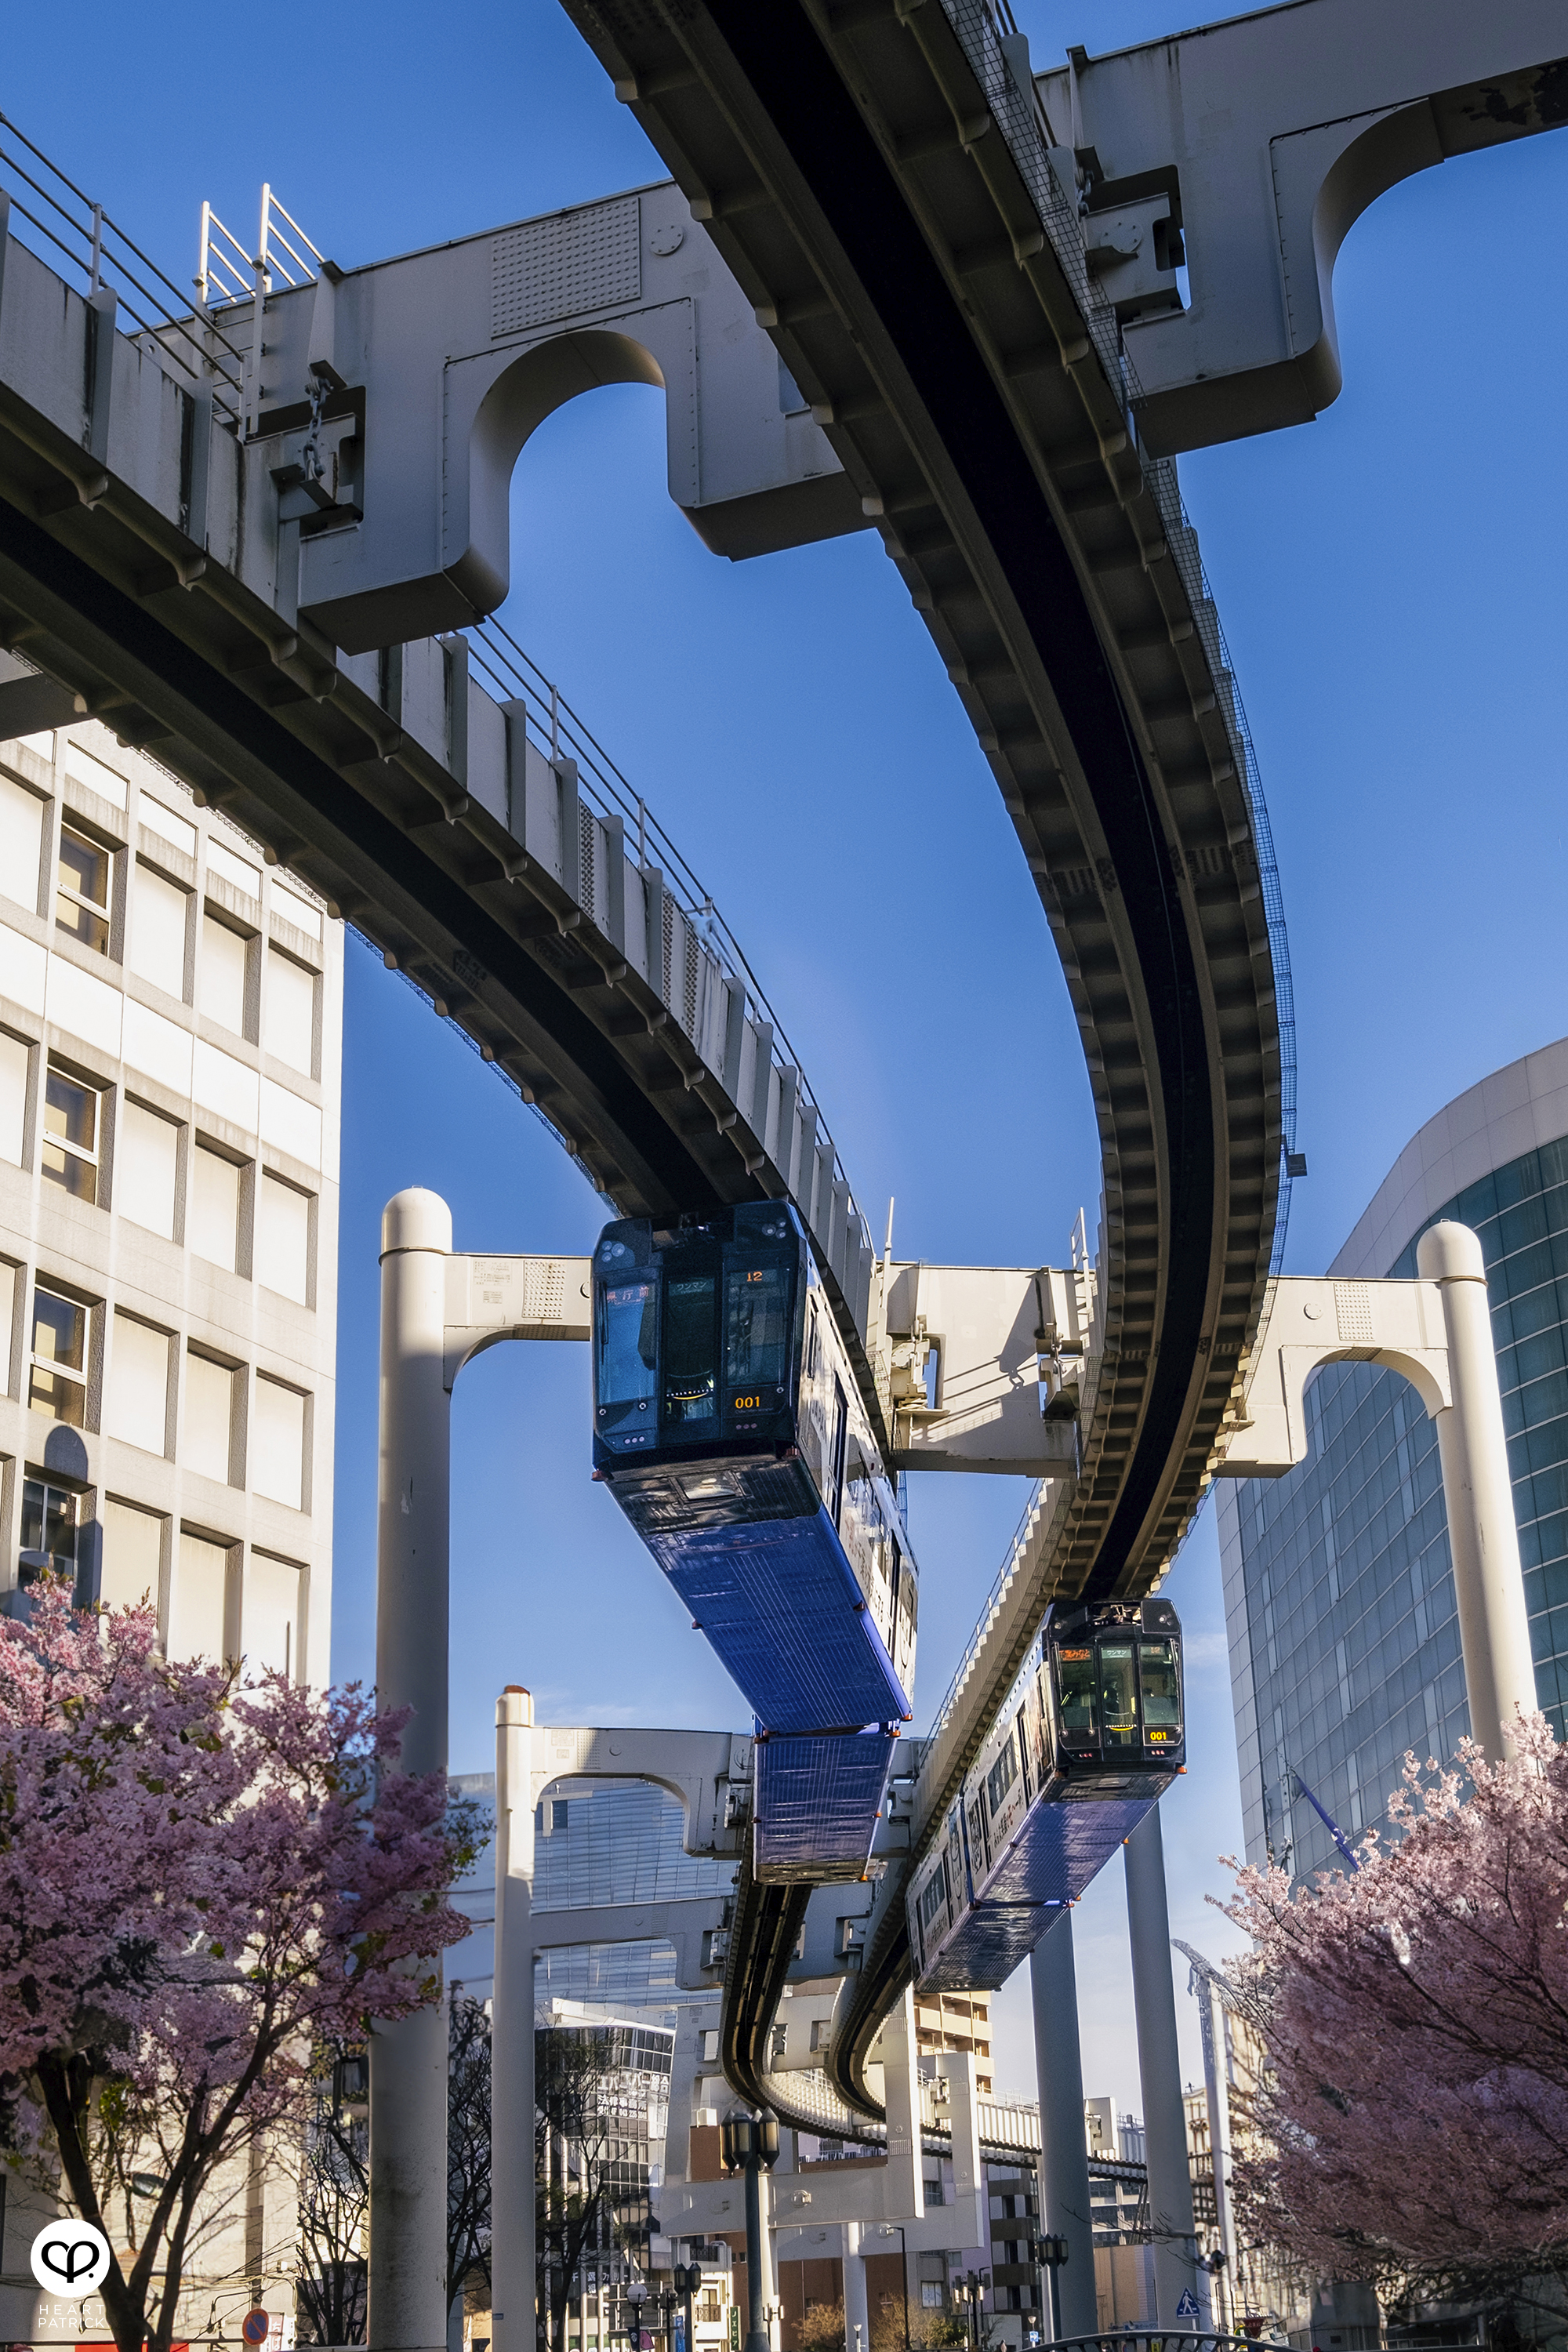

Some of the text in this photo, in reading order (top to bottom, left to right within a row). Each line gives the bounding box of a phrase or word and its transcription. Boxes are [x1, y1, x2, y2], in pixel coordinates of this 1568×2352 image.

[746, 1271, 763, 1282] 12
[677, 1281, 706, 1291] ワンマン
[735, 1396, 760, 1409] 001
[1150, 1731, 1167, 1740] 001
